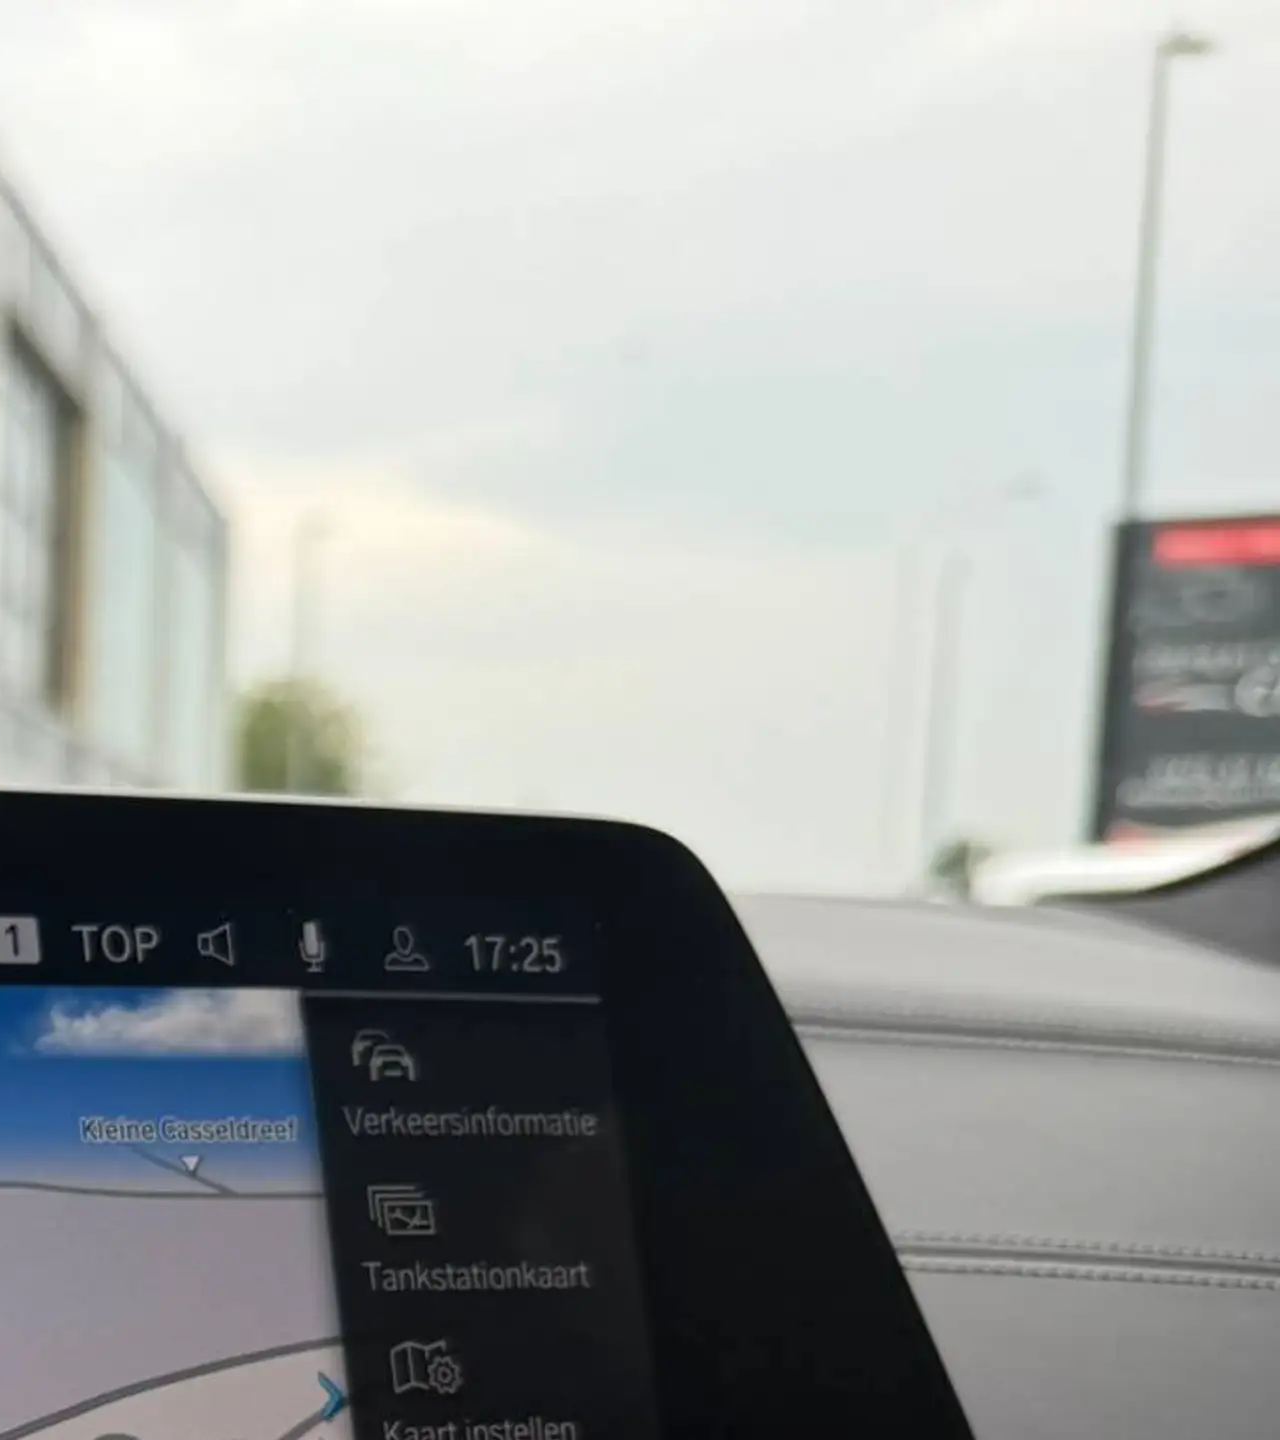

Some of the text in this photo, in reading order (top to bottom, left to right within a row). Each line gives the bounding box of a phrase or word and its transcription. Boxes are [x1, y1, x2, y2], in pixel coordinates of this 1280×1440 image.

[71, 923, 161, 963] TOP
[462, 935, 564, 974] 17:25
[82, 1118, 155, 1141] Kleine
[343, 1105, 599, 1139] Verkeersinformatie
[362, 1259, 591, 1293] Tankstationkaart
